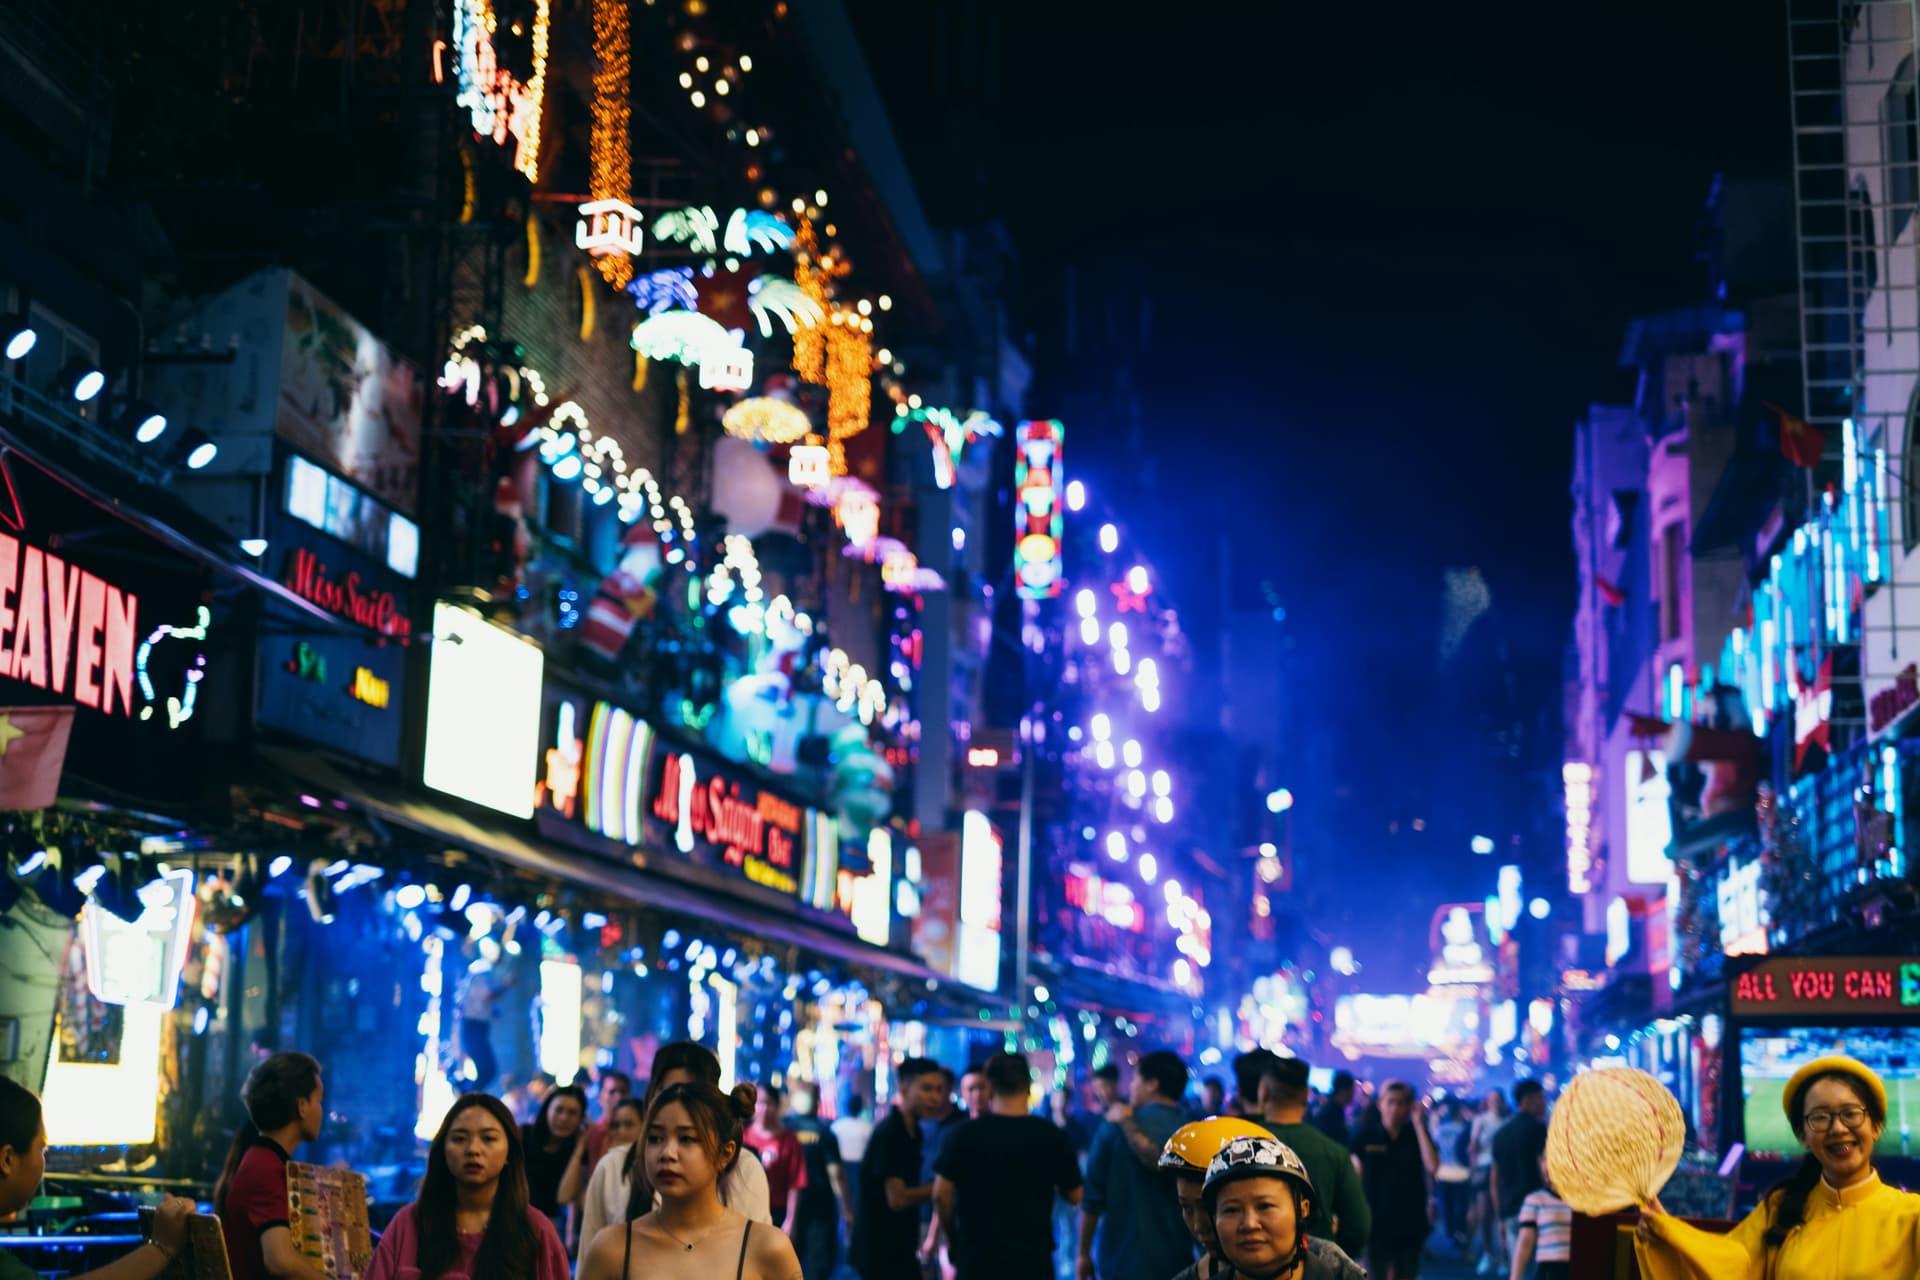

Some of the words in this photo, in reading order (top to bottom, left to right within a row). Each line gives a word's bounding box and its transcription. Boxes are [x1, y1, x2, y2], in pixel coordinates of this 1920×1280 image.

[286, 548, 343, 613] Miss
[1737, 971, 1777, 1001] ALL
[1789, 971, 1835, 999] YOU
[1844, 970, 1892, 999] CAN
